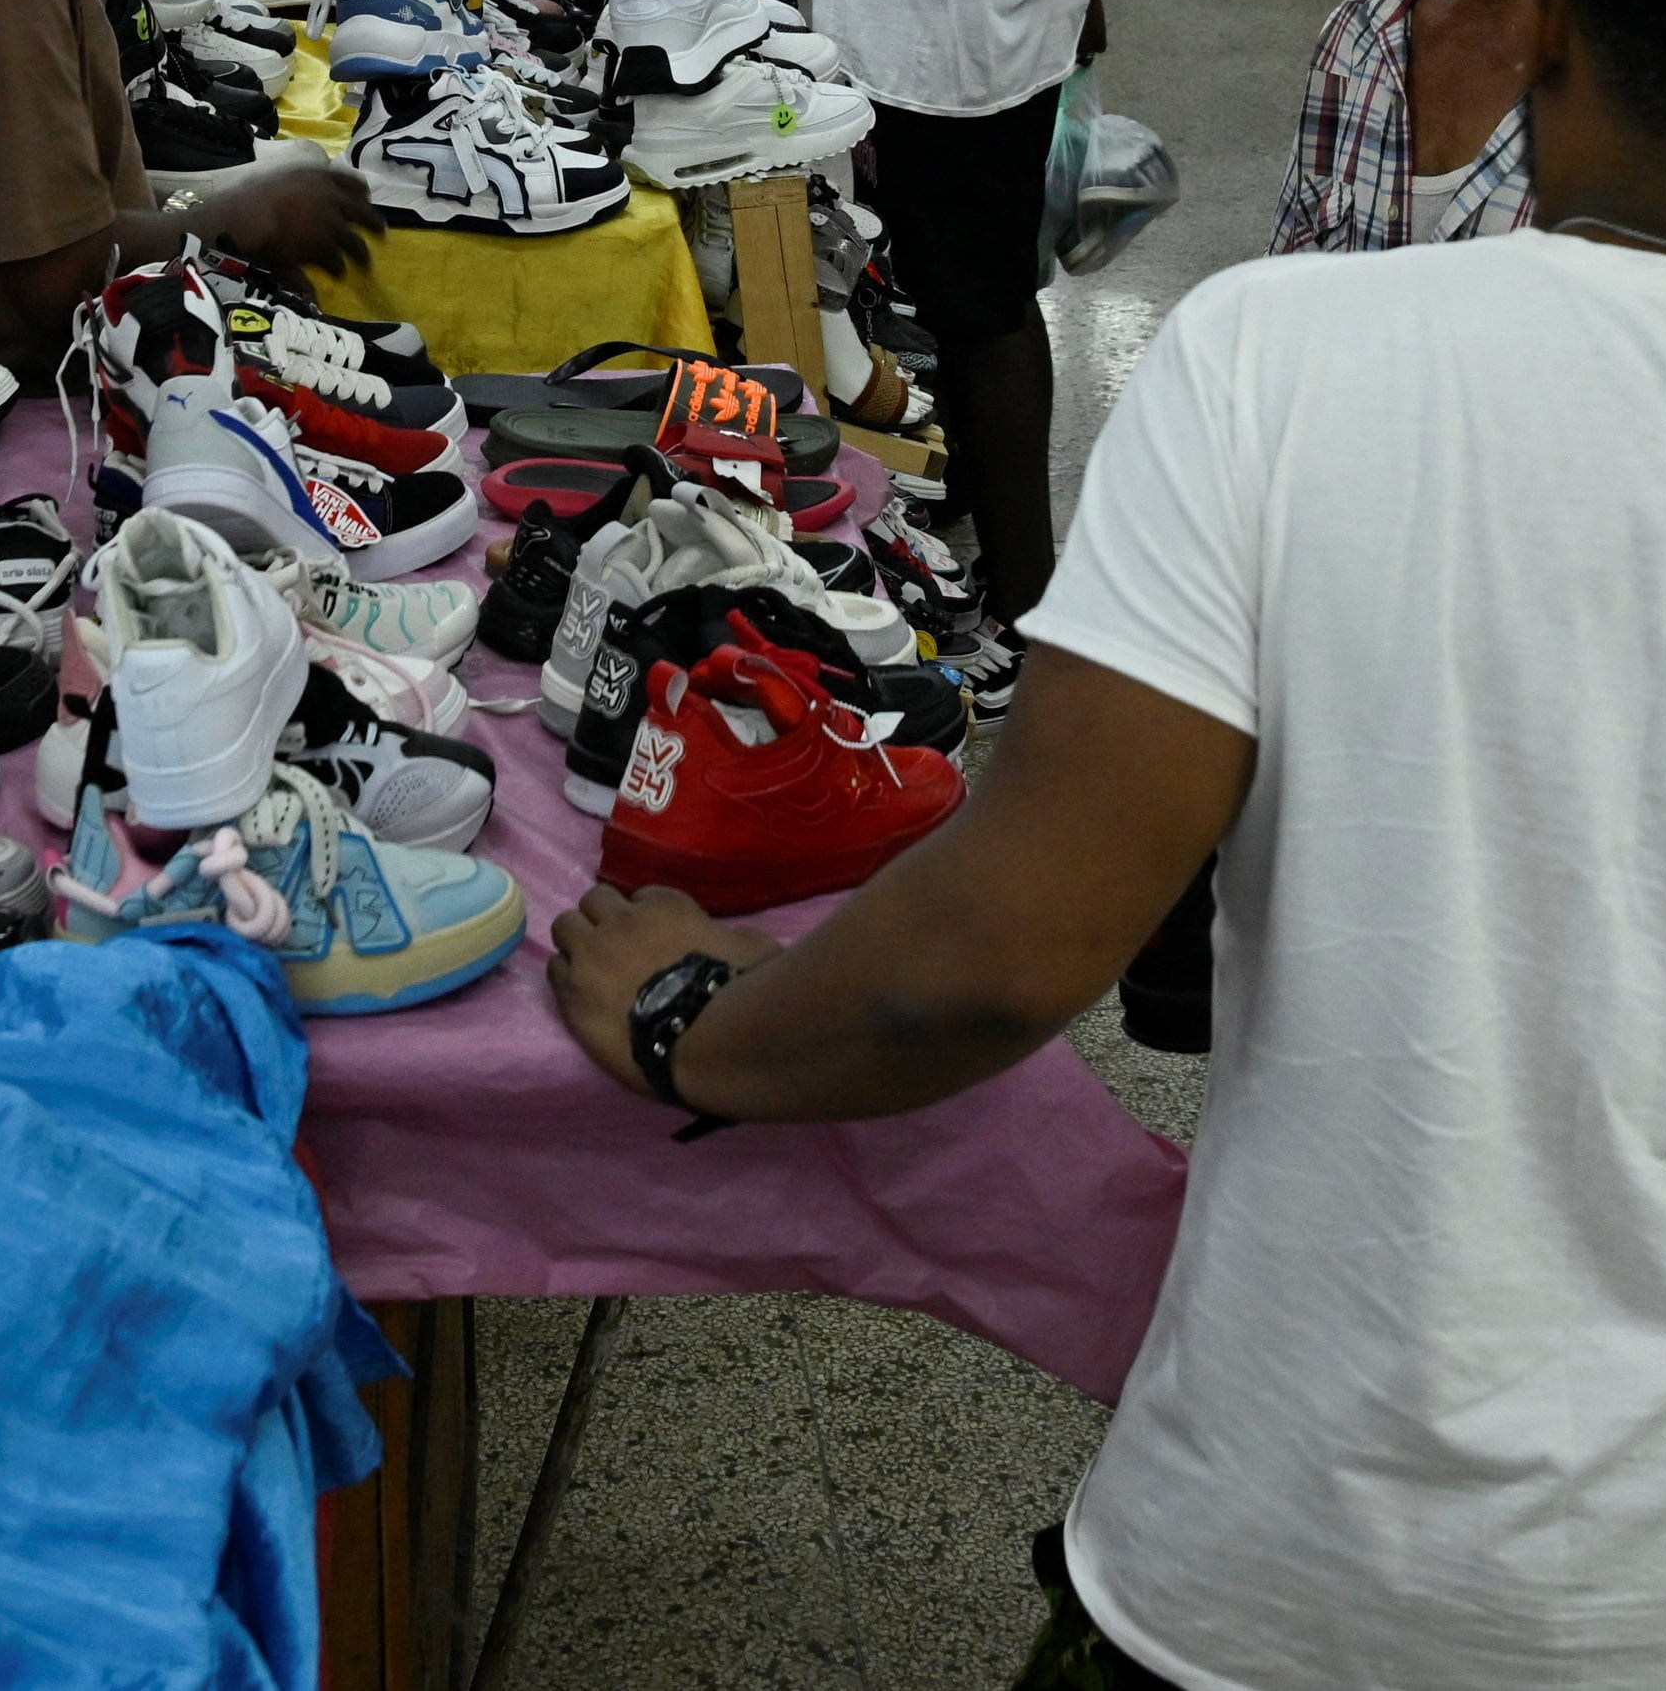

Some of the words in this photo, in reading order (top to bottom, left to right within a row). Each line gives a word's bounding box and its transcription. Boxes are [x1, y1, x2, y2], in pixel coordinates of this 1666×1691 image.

[688, 381, 706, 422] adidas
[744, 394, 762, 434] adidas
[312, 482, 350, 513] VANS
